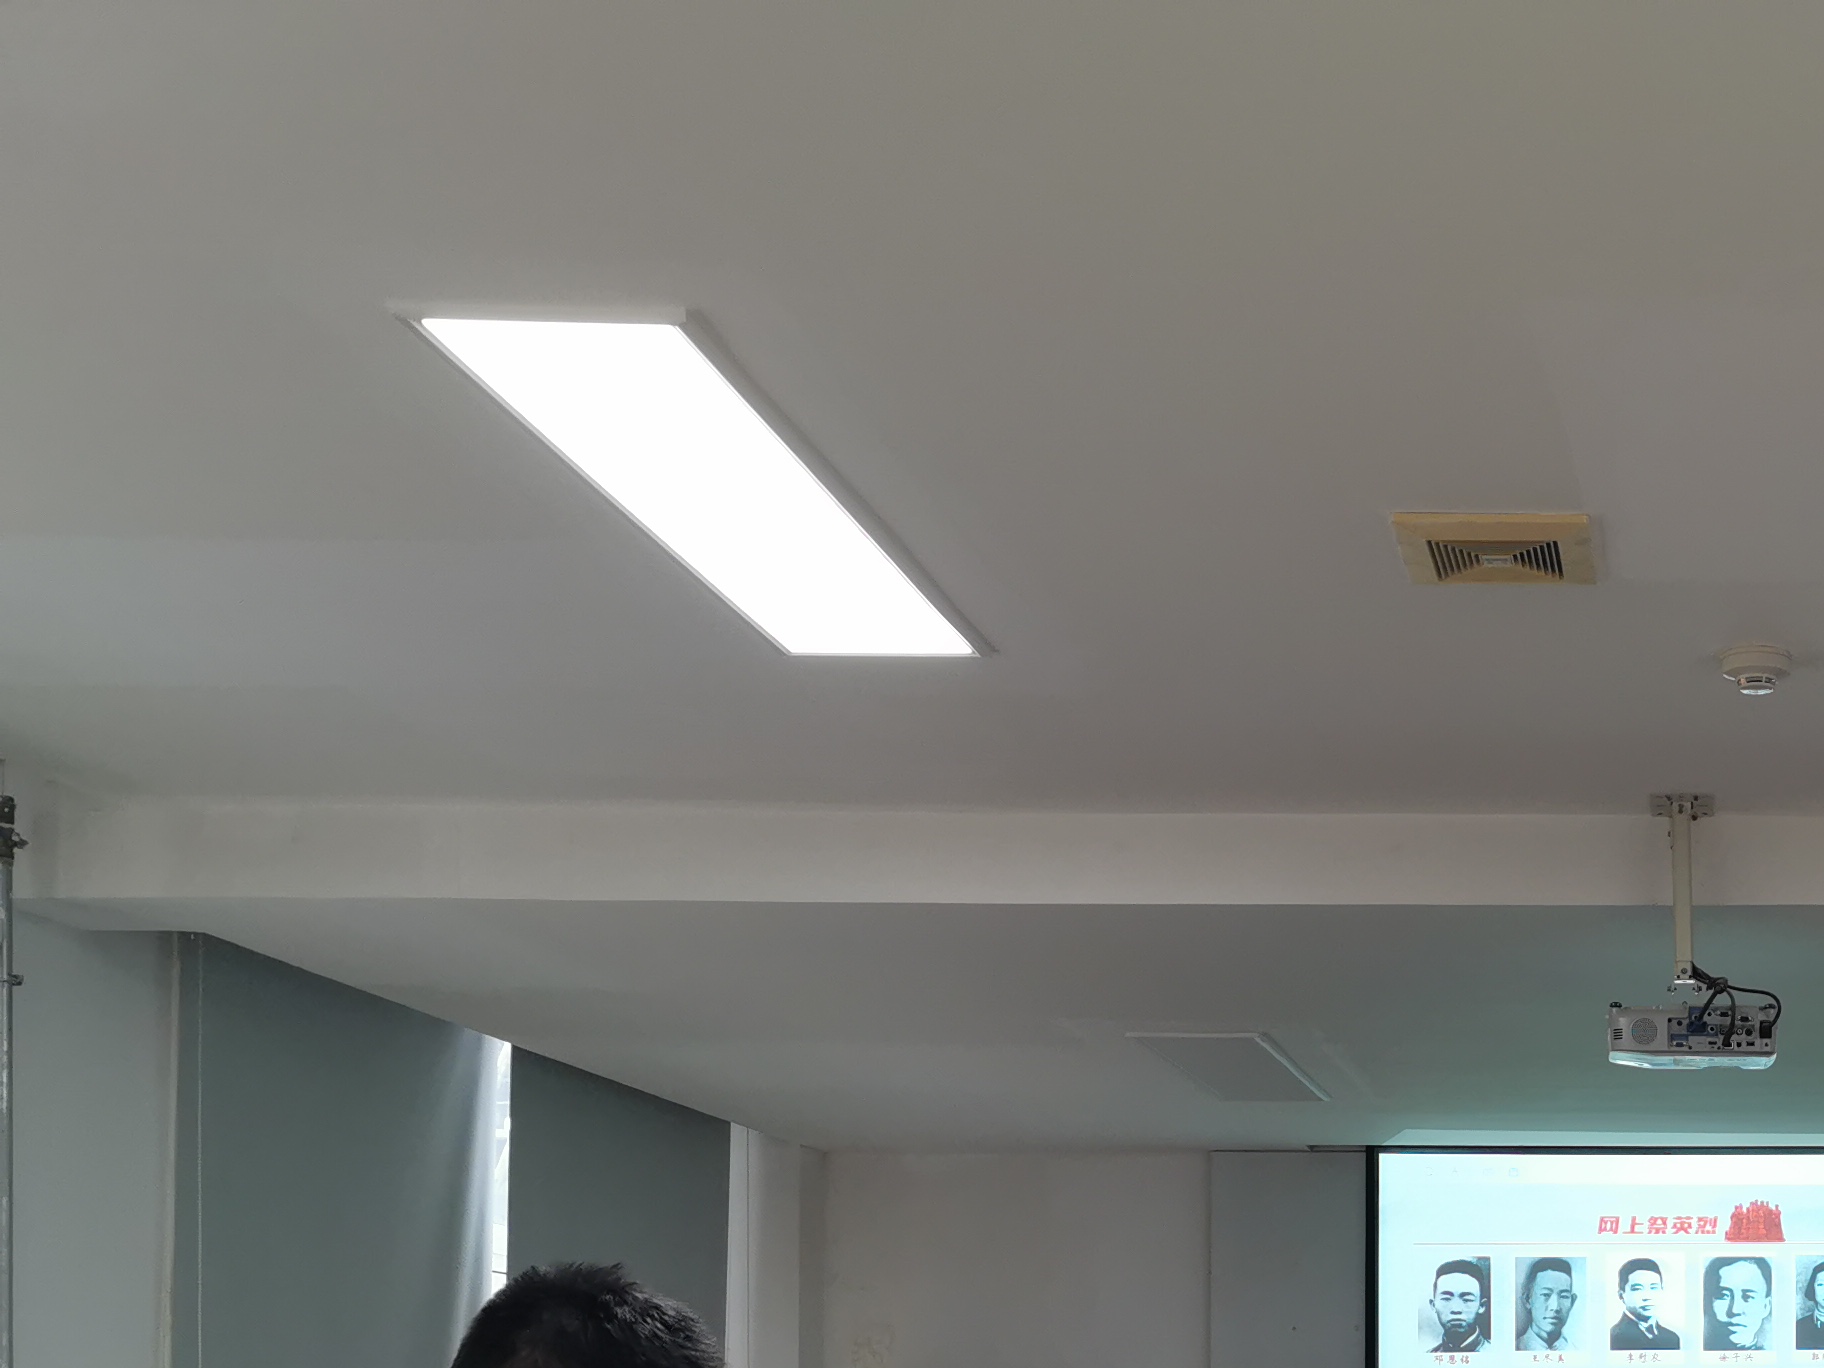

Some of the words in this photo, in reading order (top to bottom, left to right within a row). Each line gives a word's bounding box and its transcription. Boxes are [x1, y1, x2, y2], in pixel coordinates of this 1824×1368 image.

[1597, 1215, 1718, 1235] 网上祭英烈
